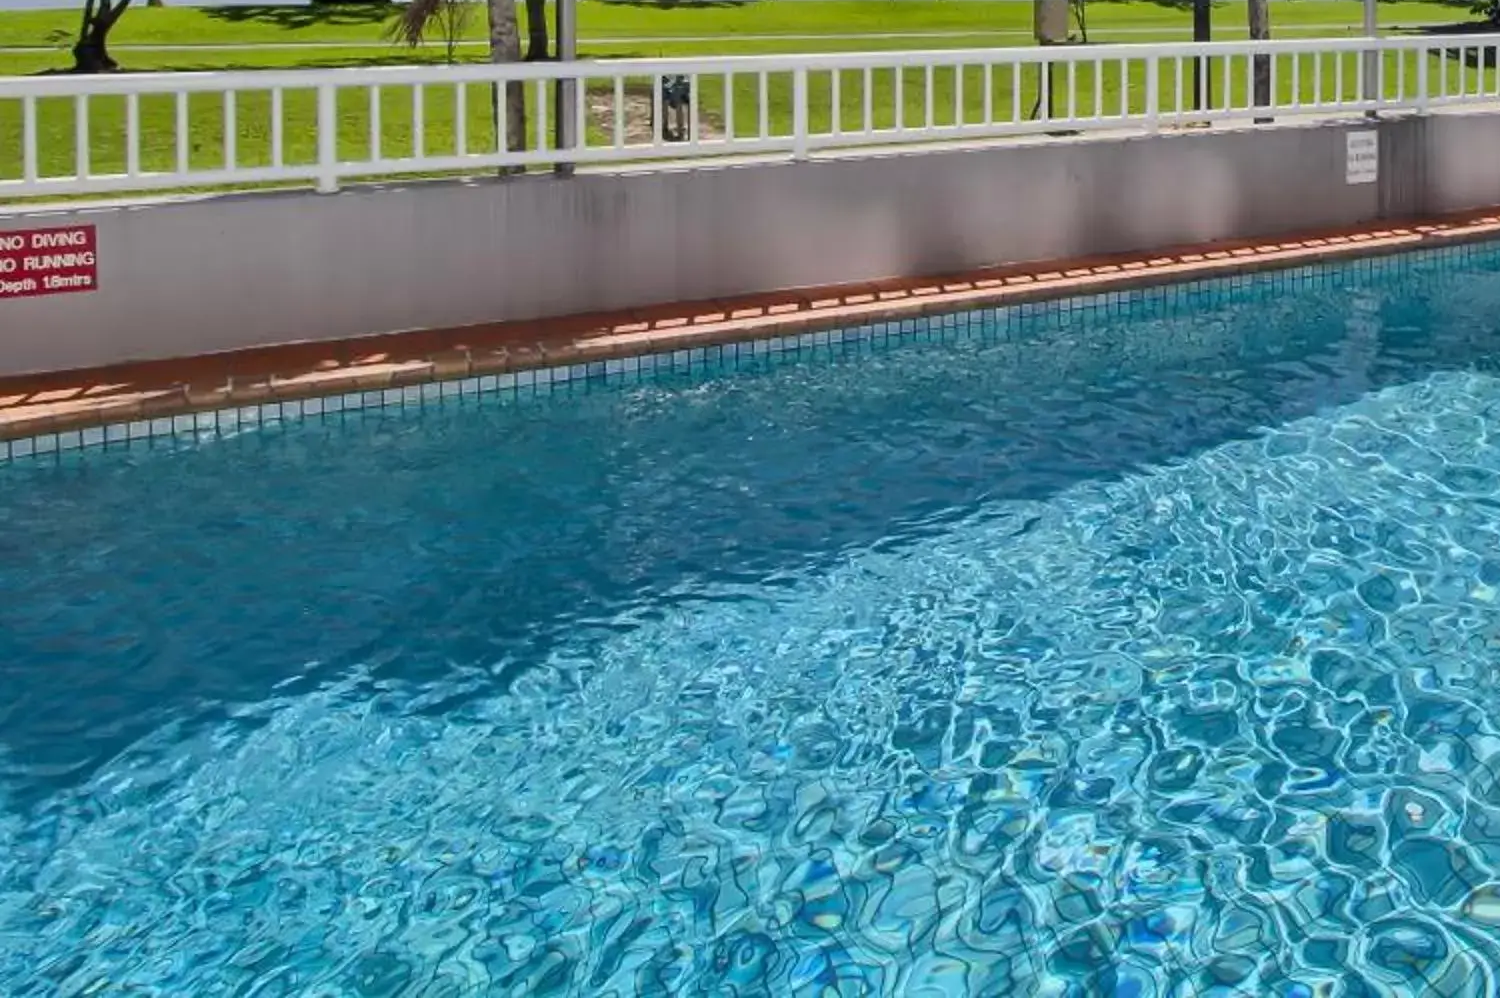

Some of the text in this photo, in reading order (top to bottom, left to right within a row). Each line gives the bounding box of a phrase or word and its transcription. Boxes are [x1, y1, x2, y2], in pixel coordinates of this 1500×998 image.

[0, 231, 87, 251] NO DIVING
[0, 251, 95, 273] O RUNNING
